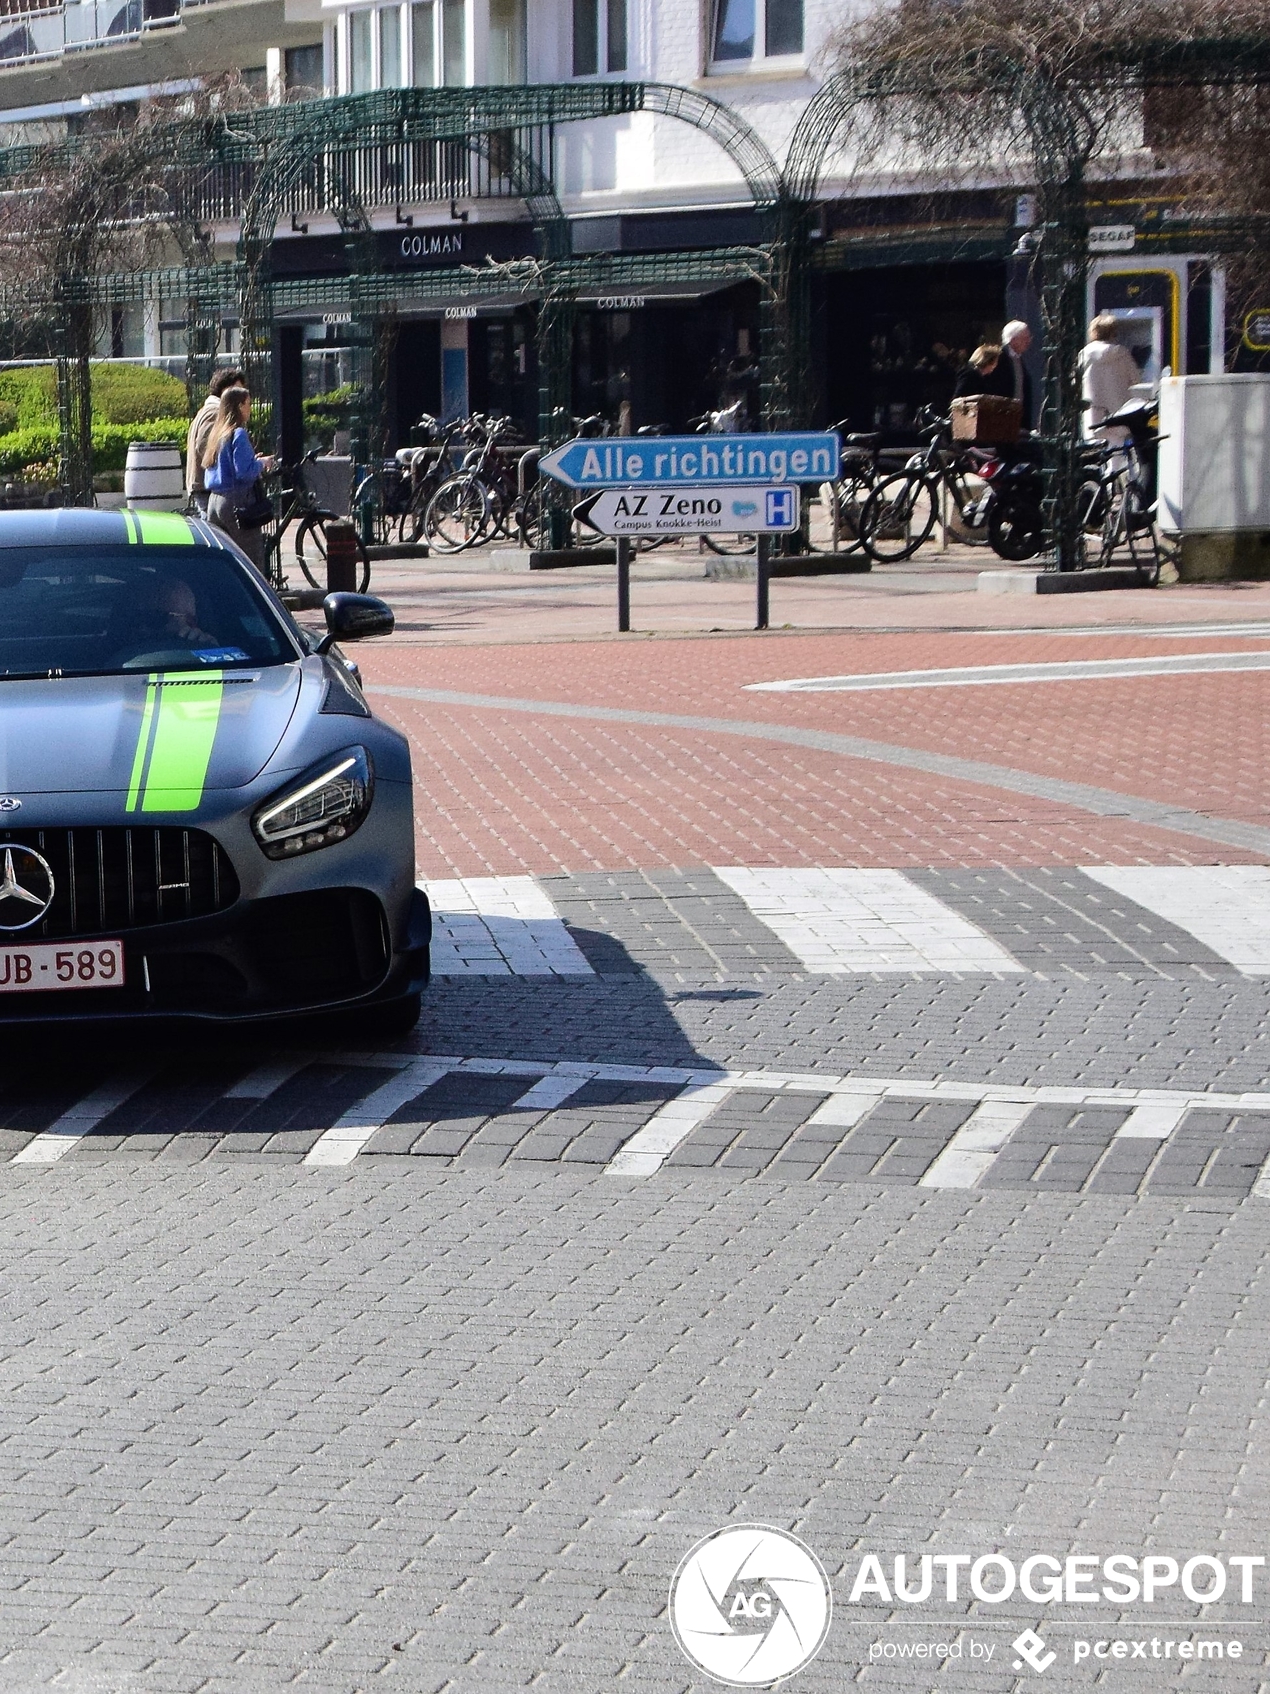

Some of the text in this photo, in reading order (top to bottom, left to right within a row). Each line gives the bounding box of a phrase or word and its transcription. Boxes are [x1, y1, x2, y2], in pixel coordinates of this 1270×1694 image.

[401, 233, 462, 256] COLMAN
[597, 296, 645, 309] COLMAN
[322, 311, 351, 324] COLMAN
[445, 306, 477, 319] COLMAN
[581, 444, 830, 483] Alle richtingen
[613, 494, 722, 517] AZ Zeno
[767, 492, 791, 524] H
[614, 518, 722, 530] Campus Knokke-Heist
